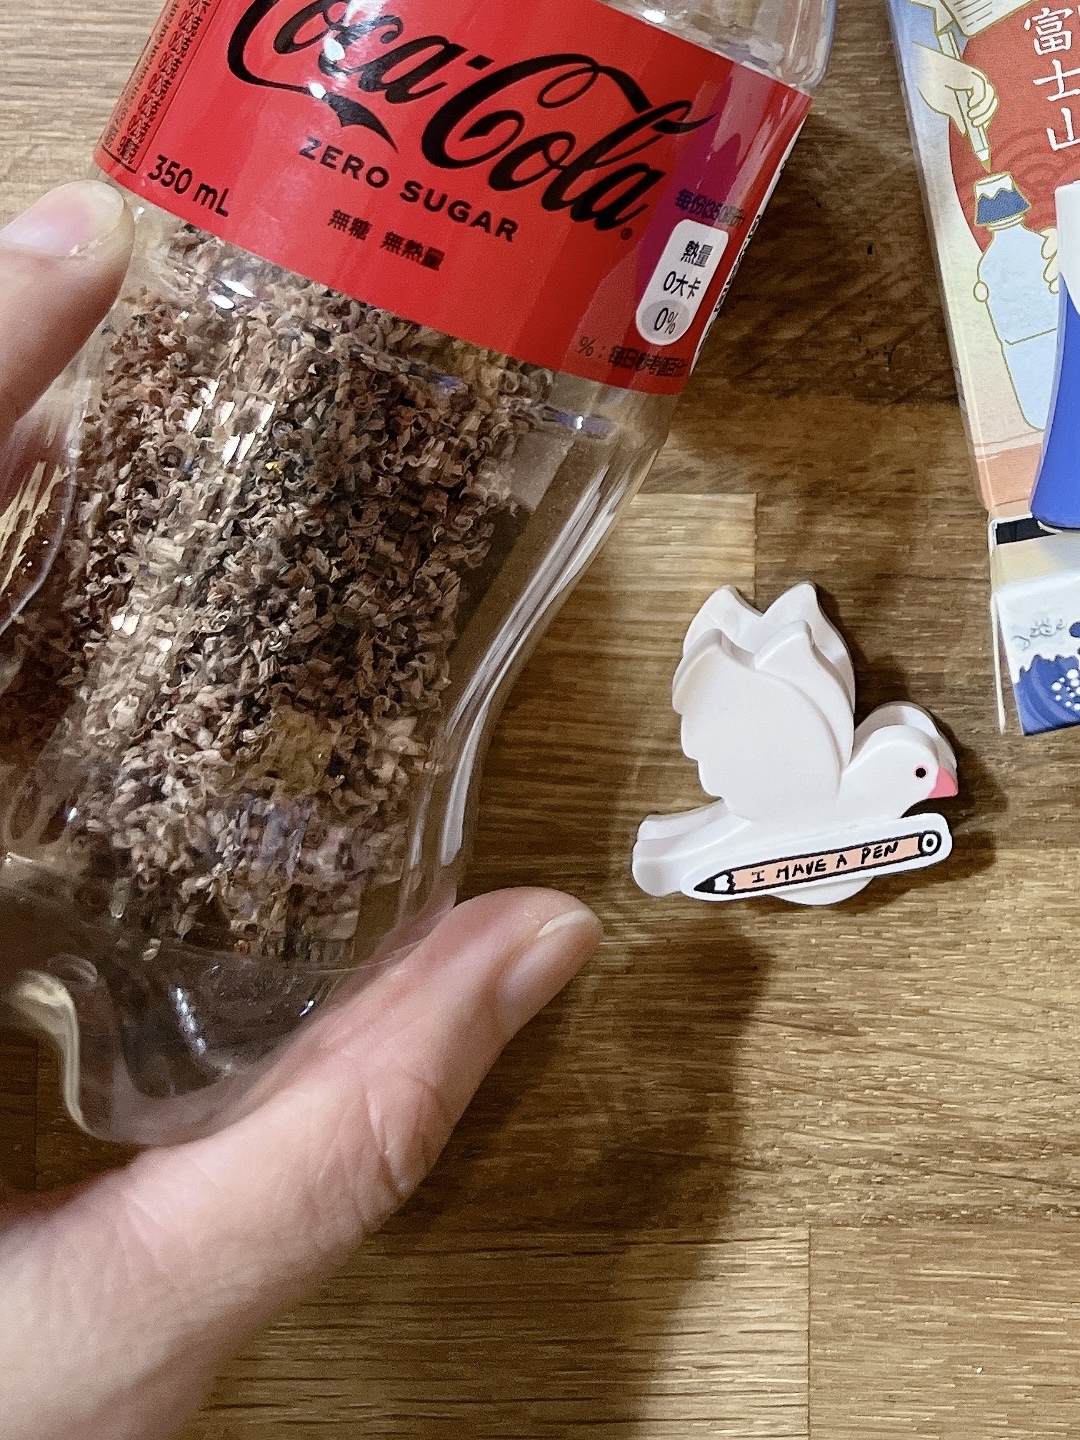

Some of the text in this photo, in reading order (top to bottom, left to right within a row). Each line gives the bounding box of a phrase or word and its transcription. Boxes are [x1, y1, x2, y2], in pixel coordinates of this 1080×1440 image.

[148, 154, 231, 218] 350 mL
[298, 135, 519, 243] ZERO SUGAR
[327, 209, 446, 272] 無糖 無熱量
[679, 239, 714, 268] 熱量
[662, 270, 702, 300] 0大卡
[653, 307, 680, 336] 0%
[750, 840, 900, 884] I HAVE A PEN
